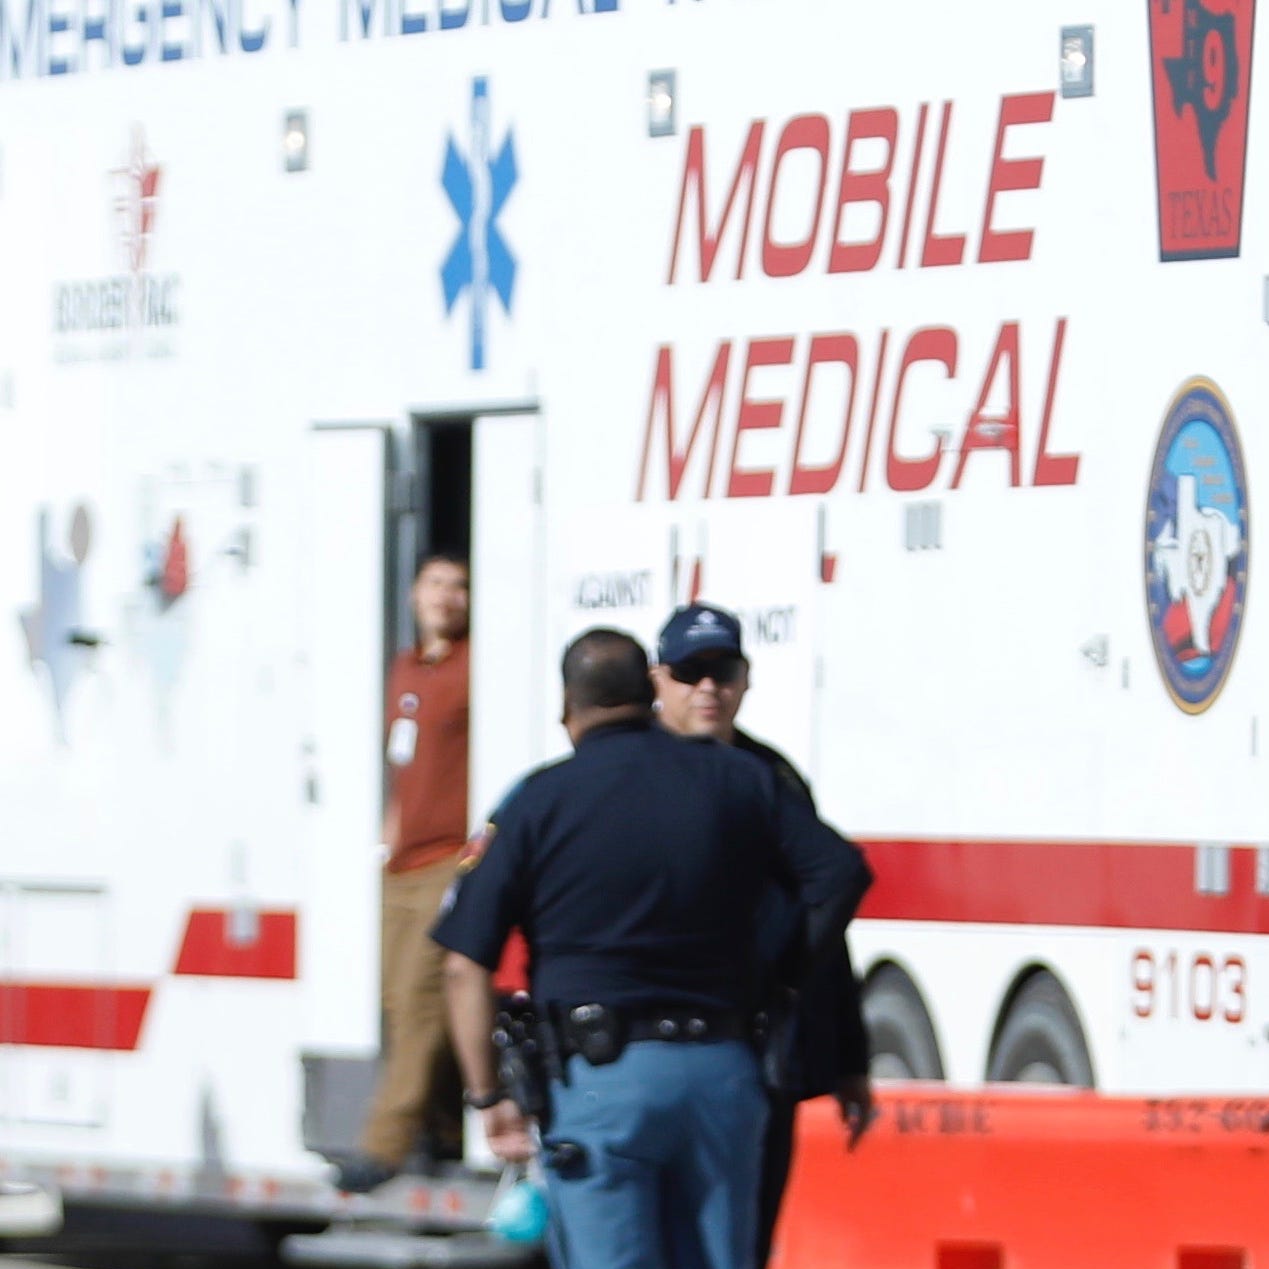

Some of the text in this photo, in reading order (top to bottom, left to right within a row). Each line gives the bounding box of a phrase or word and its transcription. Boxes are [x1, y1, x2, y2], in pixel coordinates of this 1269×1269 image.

[666, 91, 1057, 285] MOBILE
[1168, 188, 1234, 239] TEXAS
[634, 316, 1082, 502] MEDICAL
[1130, 949, 1248, 1023] 9103
